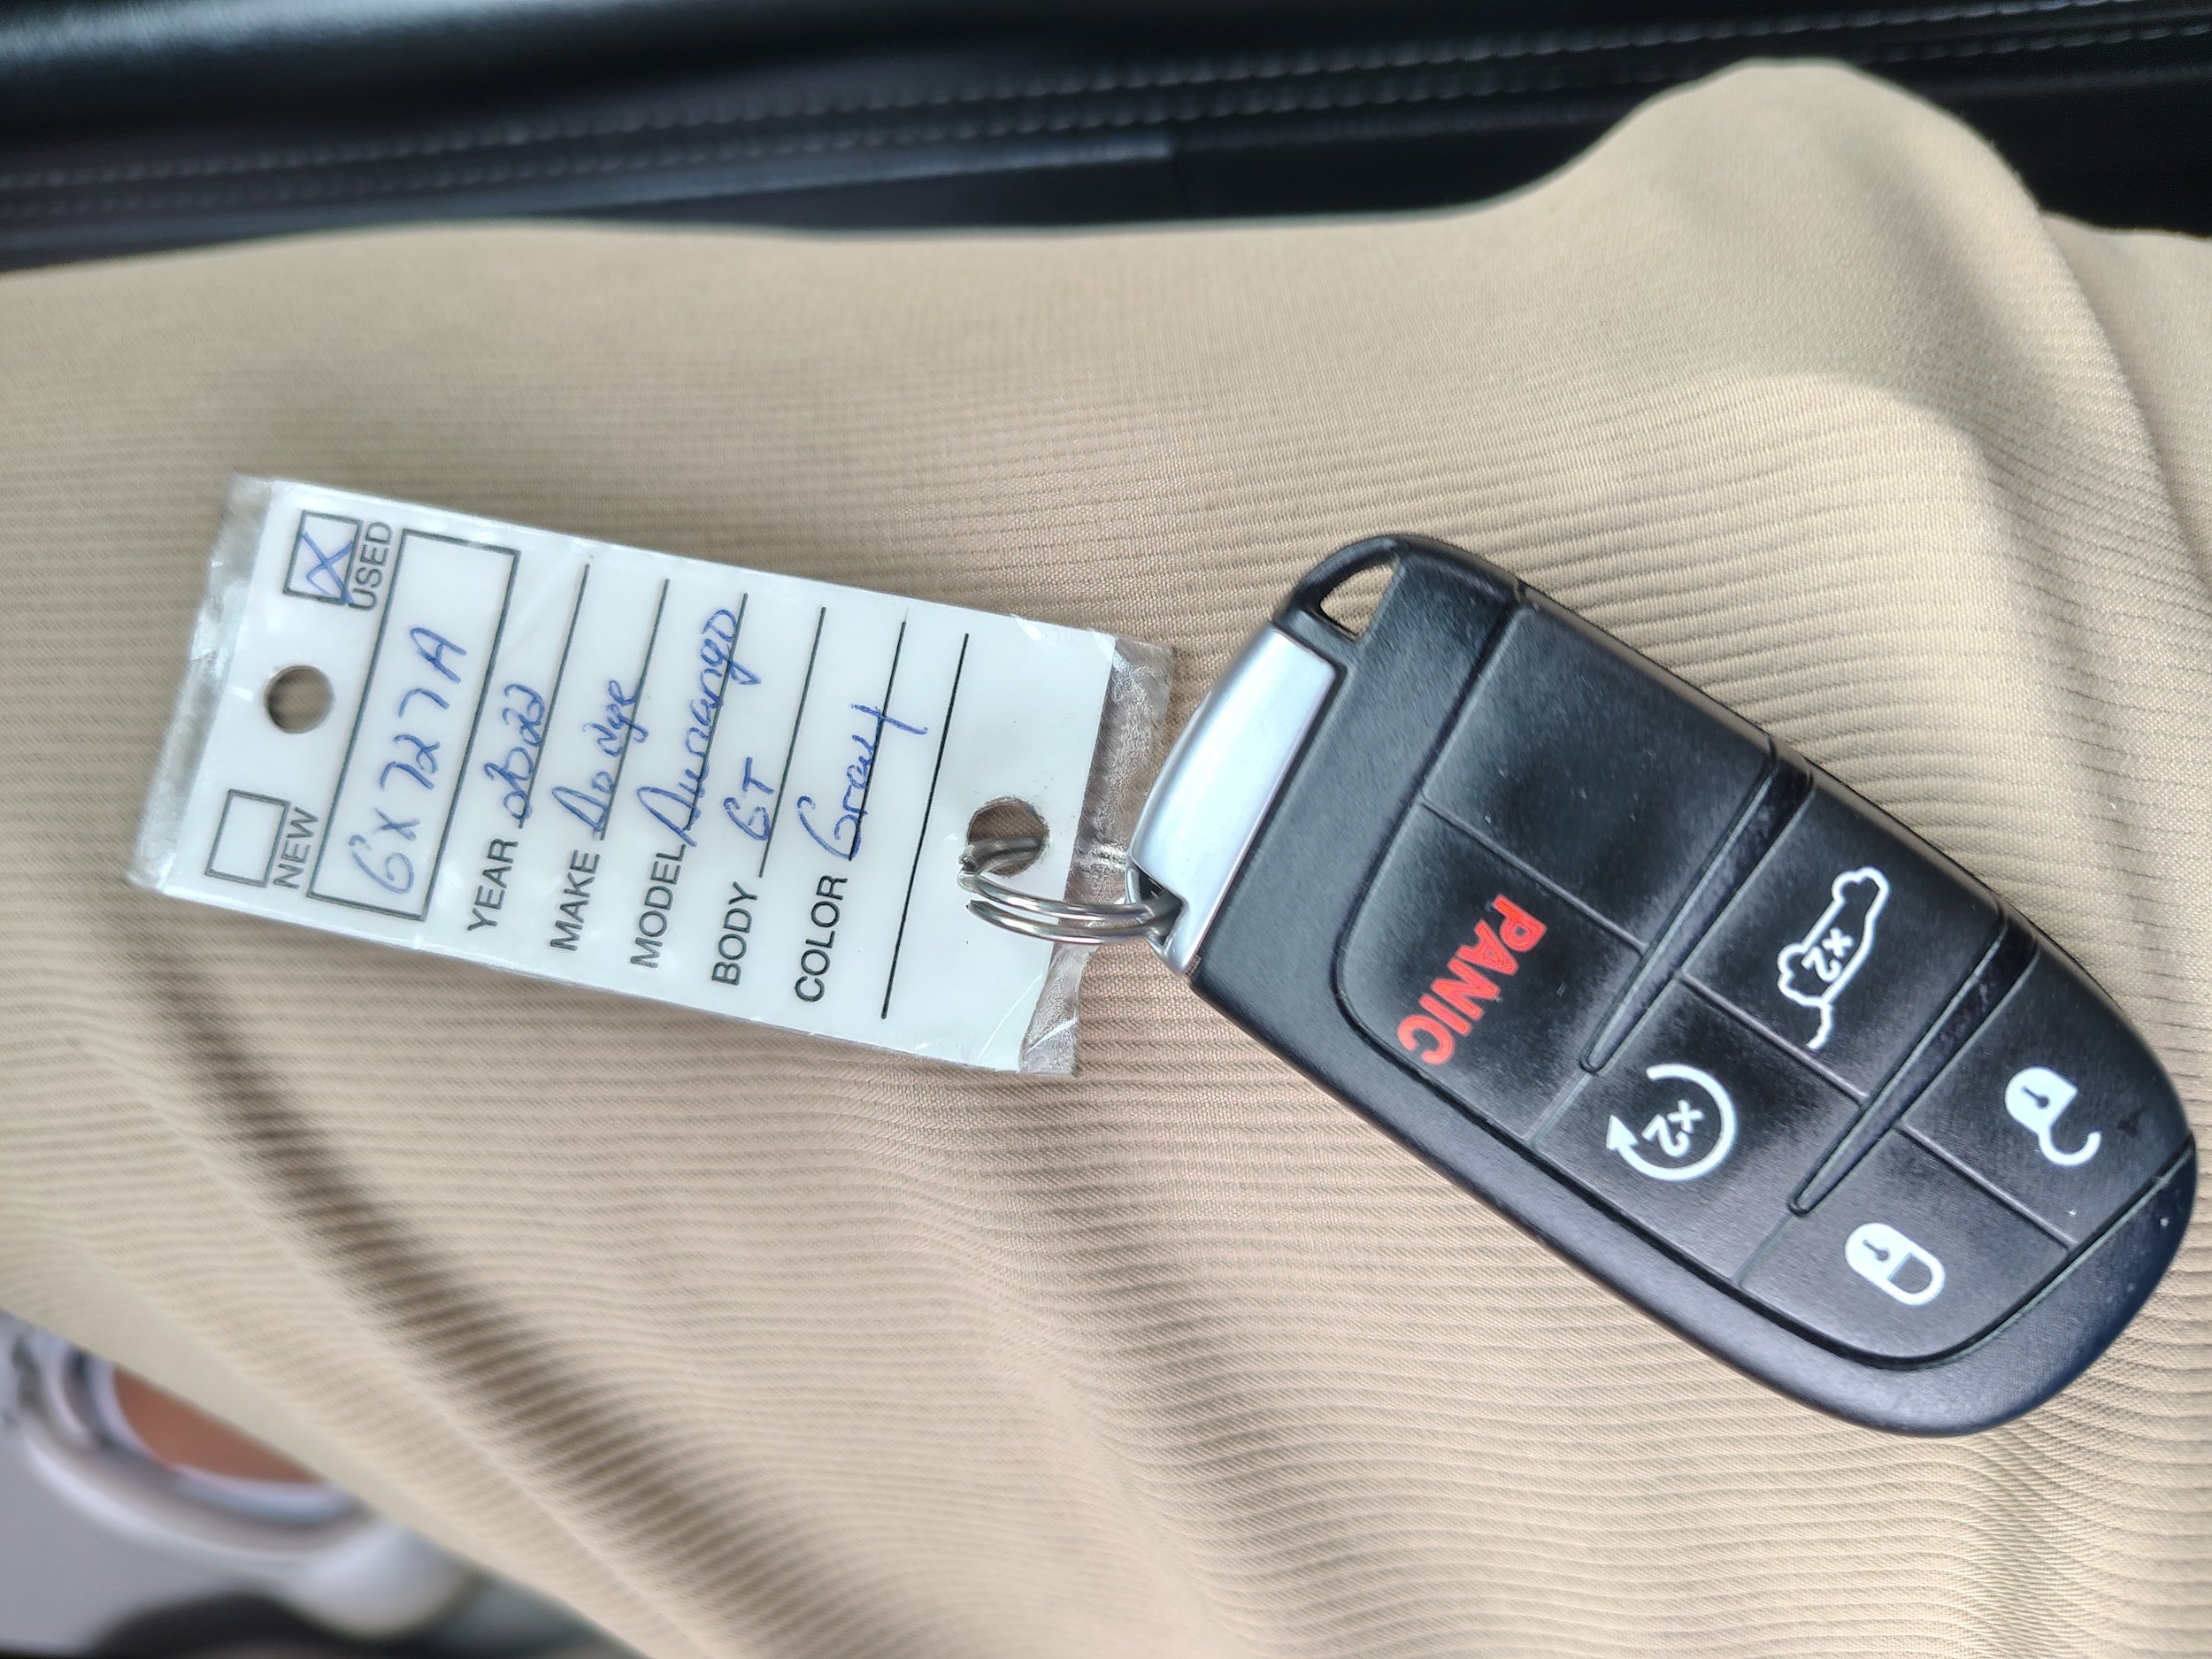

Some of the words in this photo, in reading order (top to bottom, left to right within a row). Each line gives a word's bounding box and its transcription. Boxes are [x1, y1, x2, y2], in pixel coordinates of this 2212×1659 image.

[348, 521, 394, 611] USED
[550, 679, 650, 841] Dodge
[635, 608, 762, 848] Durango
[796, 702, 929, 862] Gray
[273, 807, 319, 889] NEW
[722, 756, 775, 842] GT
[466, 837, 519, 932] YEAR
[549, 849, 602, 951] MAKE
[629, 844, 687, 970] MODEL
[710, 880, 759, 987] BODY
[795, 873, 849, 1003] COLOR
[1396, 893, 1548, 1065] PANIC
